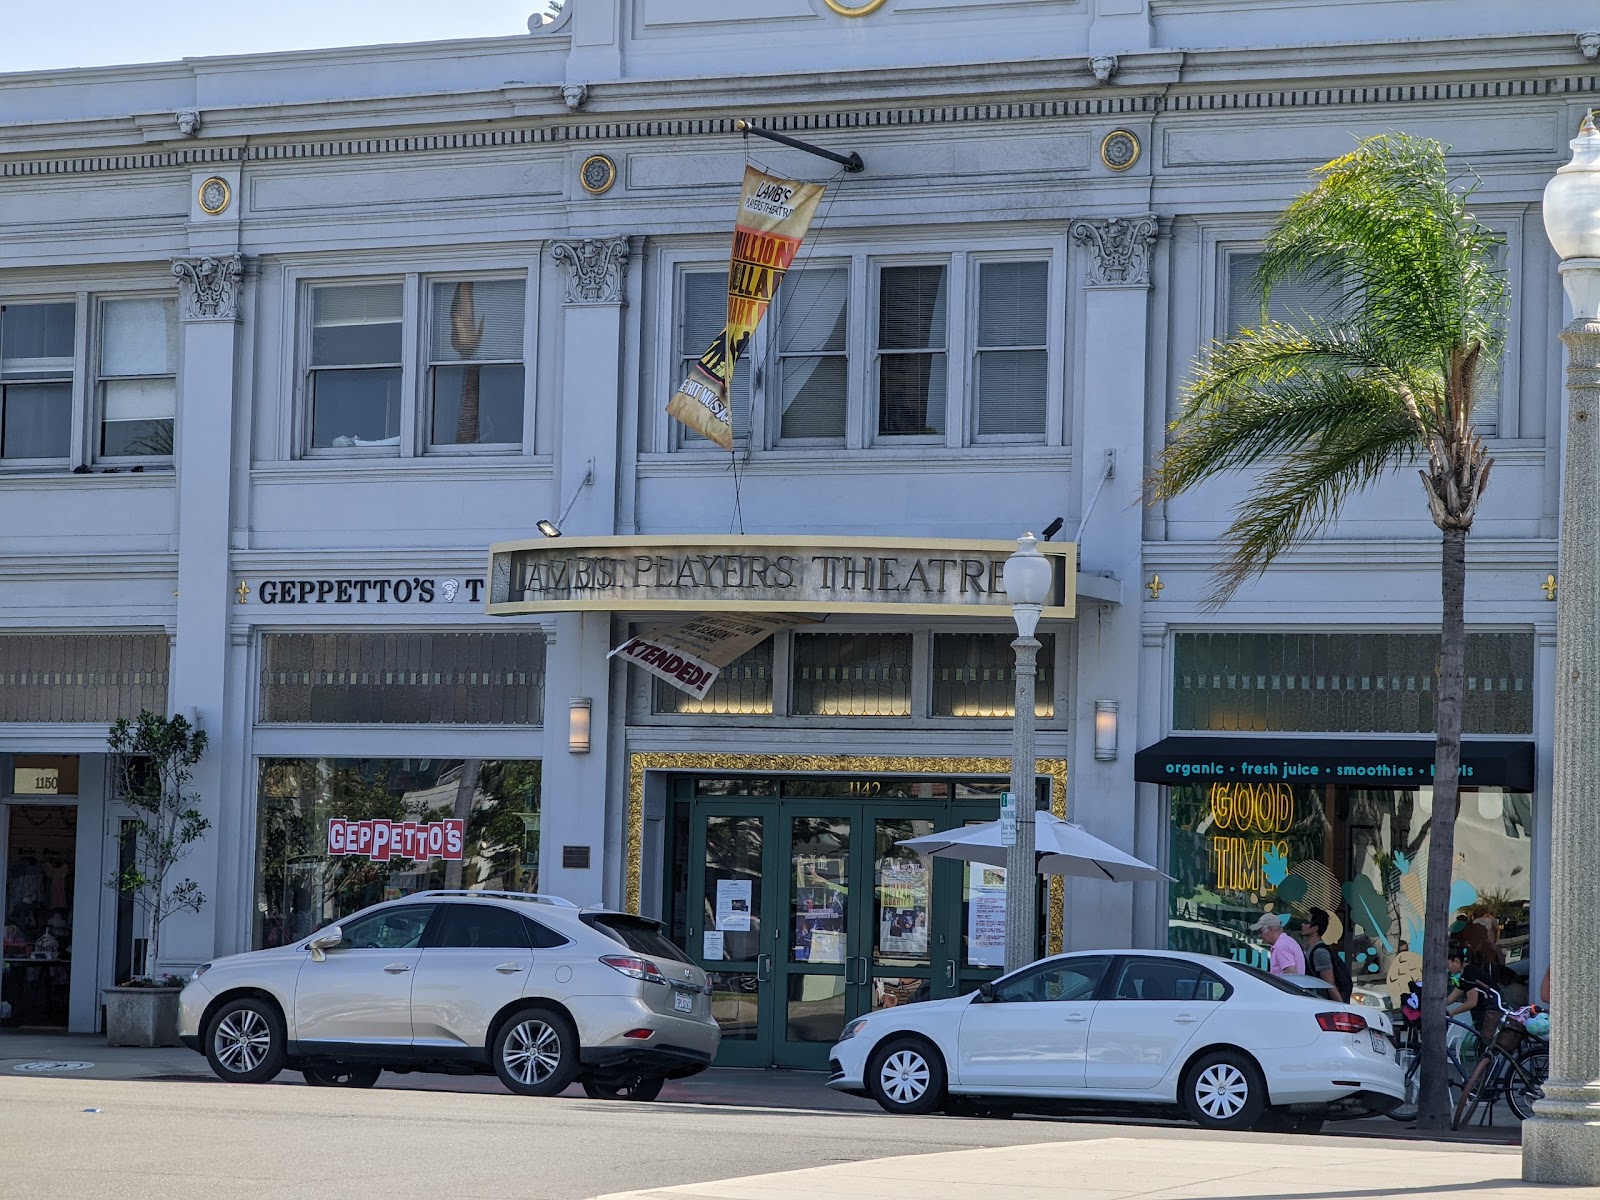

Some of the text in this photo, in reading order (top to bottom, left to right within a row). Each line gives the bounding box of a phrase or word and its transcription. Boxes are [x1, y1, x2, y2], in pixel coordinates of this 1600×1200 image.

[732, 231, 795, 269] MILLION
[515, 556, 614, 592] LAMB'S
[632, 554, 796, 589] PLAYERS
[259, 577, 435, 605] GEPPETTO'S
[622, 639, 713, 692] XTENDED!
[35, 776, 58, 790] 1150
[1165, 762, 1224, 777] organic
[1241, 761, 1278, 775] fresh
[1282, 761, 1319, 779] juice
[1336, 763, 1414, 777] smoothies
[849, 781, 881, 798] 1142
[1211, 782, 1294, 833] GOOD
[330, 822, 461, 857] GEPPETTO'S
